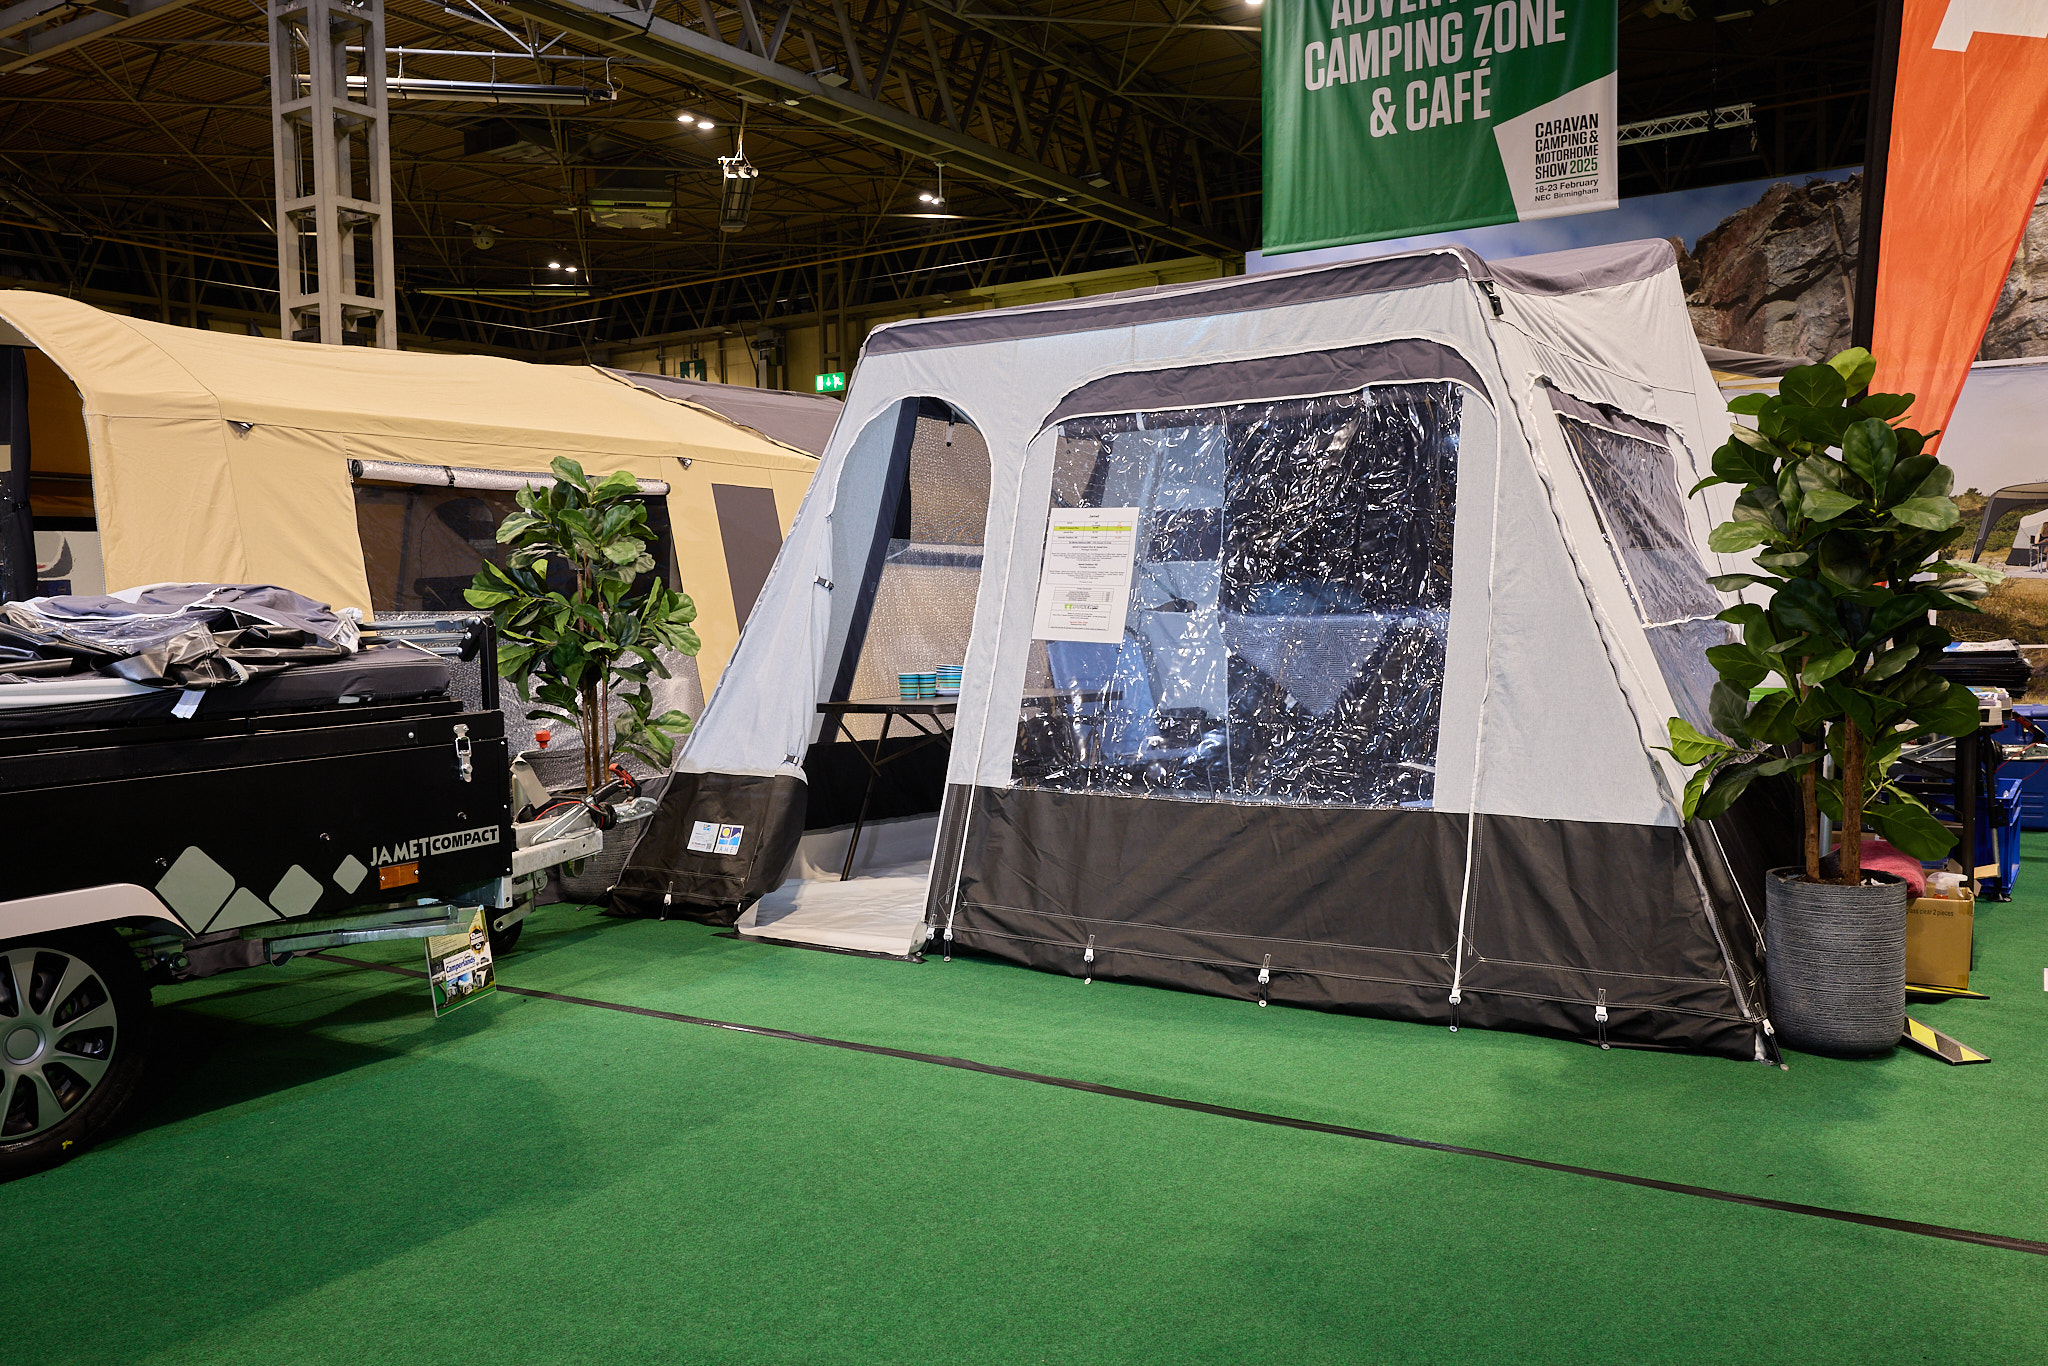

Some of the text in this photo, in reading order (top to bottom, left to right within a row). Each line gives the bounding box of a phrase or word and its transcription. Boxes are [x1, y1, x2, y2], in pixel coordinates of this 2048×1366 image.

[1304, 12, 1463, 91] CAMPING
[1473, 0, 1566, 59] ZONE
[1369, 58, 1491, 138] & CAFÉ
[1535, 113, 1599, 138] CARAVAN
[1535, 130, 1599, 152] CAMPING &
[1535, 144, 1599, 166] MOTORHOME
[1535, 157, 1598, 180] SHOW 2025
[1535, 179, 1599, 194] 18-23 February
[1535, 188, 1599, 202] NEC Birmingham
[370, 828, 498, 867] JAMET COMPACT
[715, 845, 738, 854] JAMET
[446, 955, 476, 974] Camperlands
